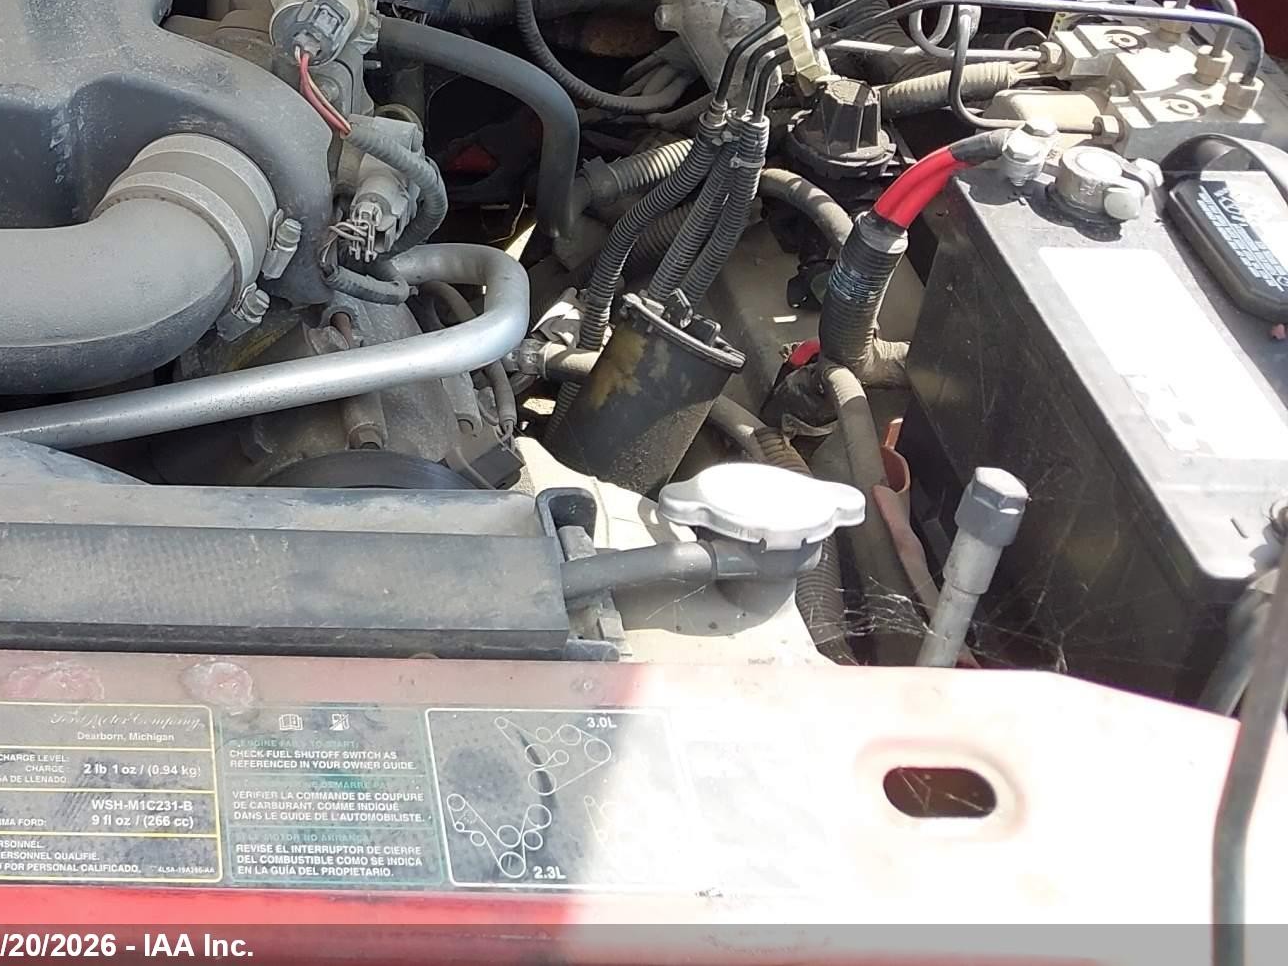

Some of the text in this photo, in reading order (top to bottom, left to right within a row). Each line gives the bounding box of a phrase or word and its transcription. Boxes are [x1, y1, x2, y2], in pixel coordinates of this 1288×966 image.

[586, 716, 618, 728] 3.0L
[129, 732, 175, 744] Michigan
[229, 749, 397, 760] CHECK FUEL SHUTOFF SWITCH AS
[230, 759, 380, 769] REFERENCED IN YOUR OWNER
[83, 763, 178, 777] 2 lb oz (0.94
[280, 791, 425, 802] LA COMMANDE DE COUPURE
[91, 799, 193, 812] WSH-M1C231-B
[233, 801, 356, 811] DE COMME
[91, 814, 194, 830] 9 oz (266 cc)
[233, 811, 425, 822] DANS LE GUIDE DE L'AUTOMOBILISTE.
[18, 818, 47, 827] FORD:
[235, 844, 422, 855] REVISE EL INTERRUPTOR DE CIERRE
[237, 855, 423, 867] DEL COMBUSTIBLE COMO SE INDICA
[4, 863, 25, 871] POR
[26, 863, 80, 872] PERSONAL
[80, 864, 141, 874] CALIFICADO.
[238, 864, 394, 877] EN LA GUÍA DEL PROPIETARIO.
[532, 866, 567, 880] 2.3L
